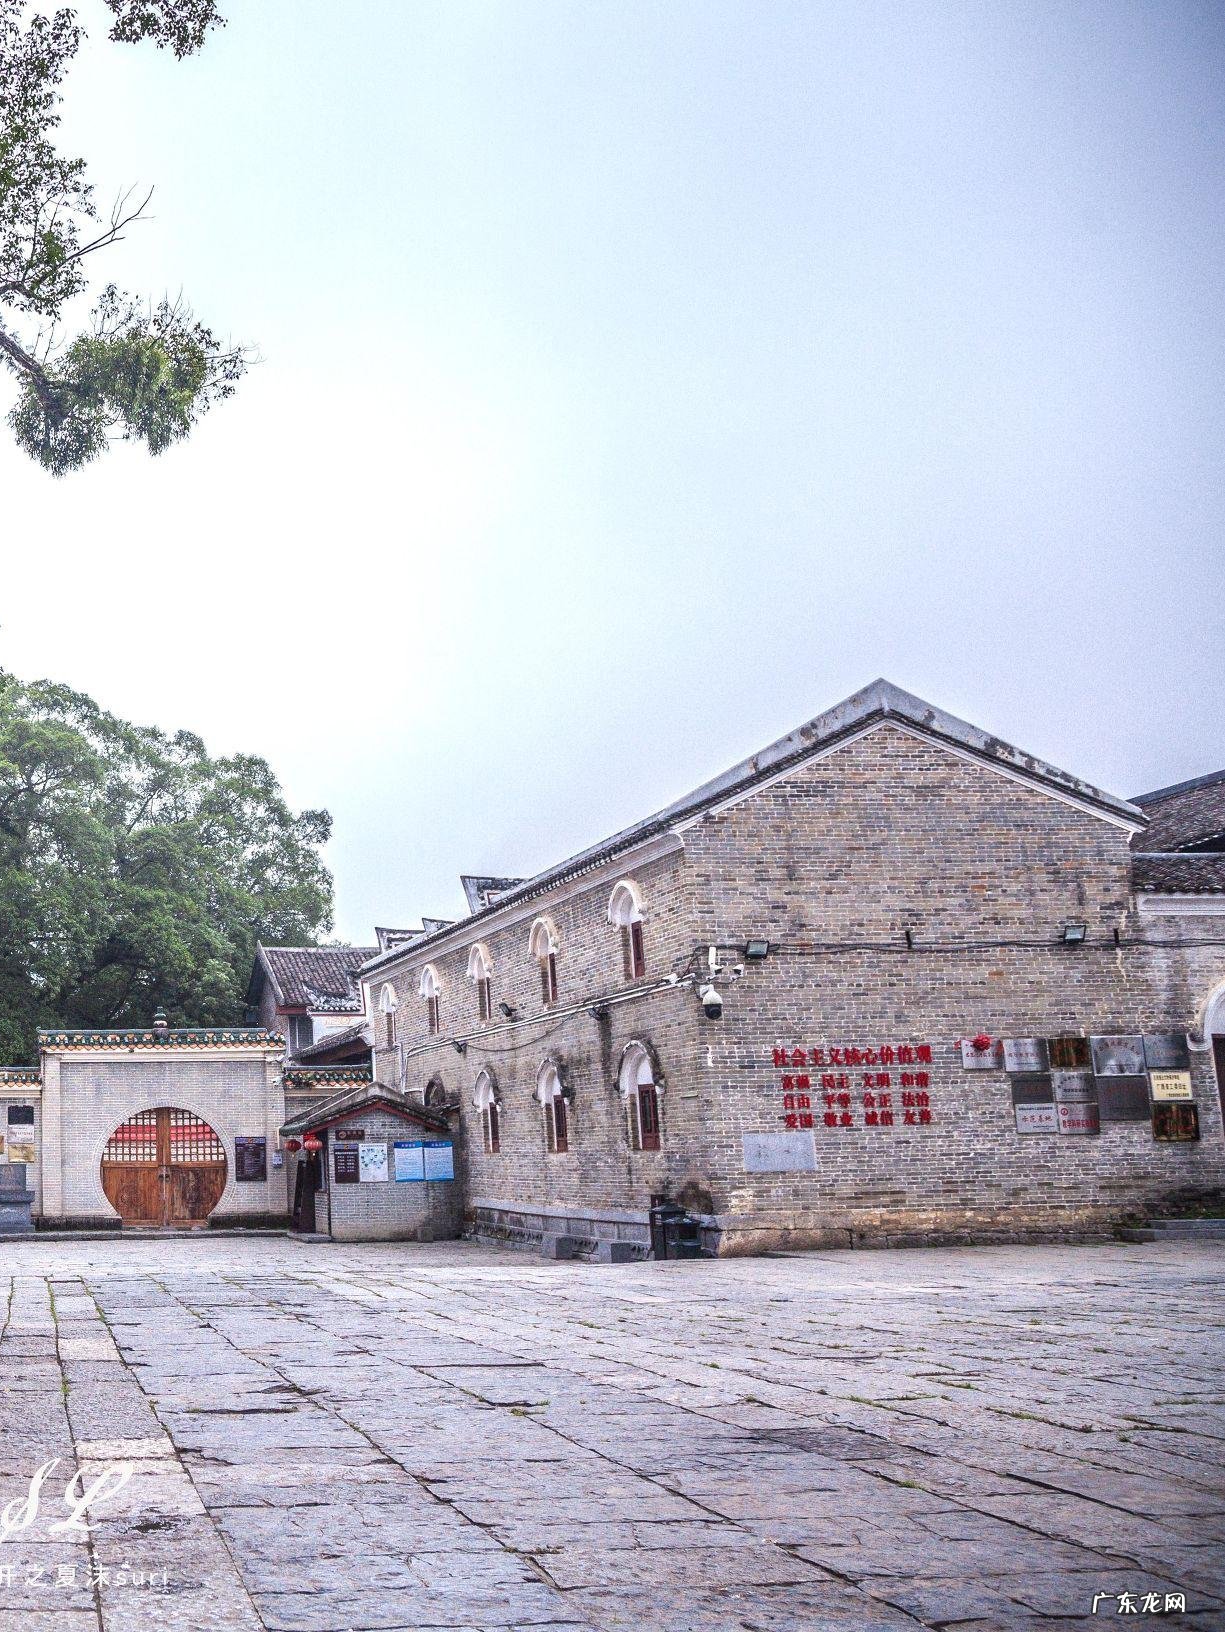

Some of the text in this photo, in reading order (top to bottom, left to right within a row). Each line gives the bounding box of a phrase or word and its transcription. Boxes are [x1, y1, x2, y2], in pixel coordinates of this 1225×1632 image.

[772, 1044, 932, 1068] 社会主义核心价值观
[782, 1072, 929, 1090] 富强 民主 文明 和谐
[783, 1091, 929, 1110] 自由 平等 公正 法治
[784, 1109, 931, 1128] 爱国 敬业 诚信 友善
